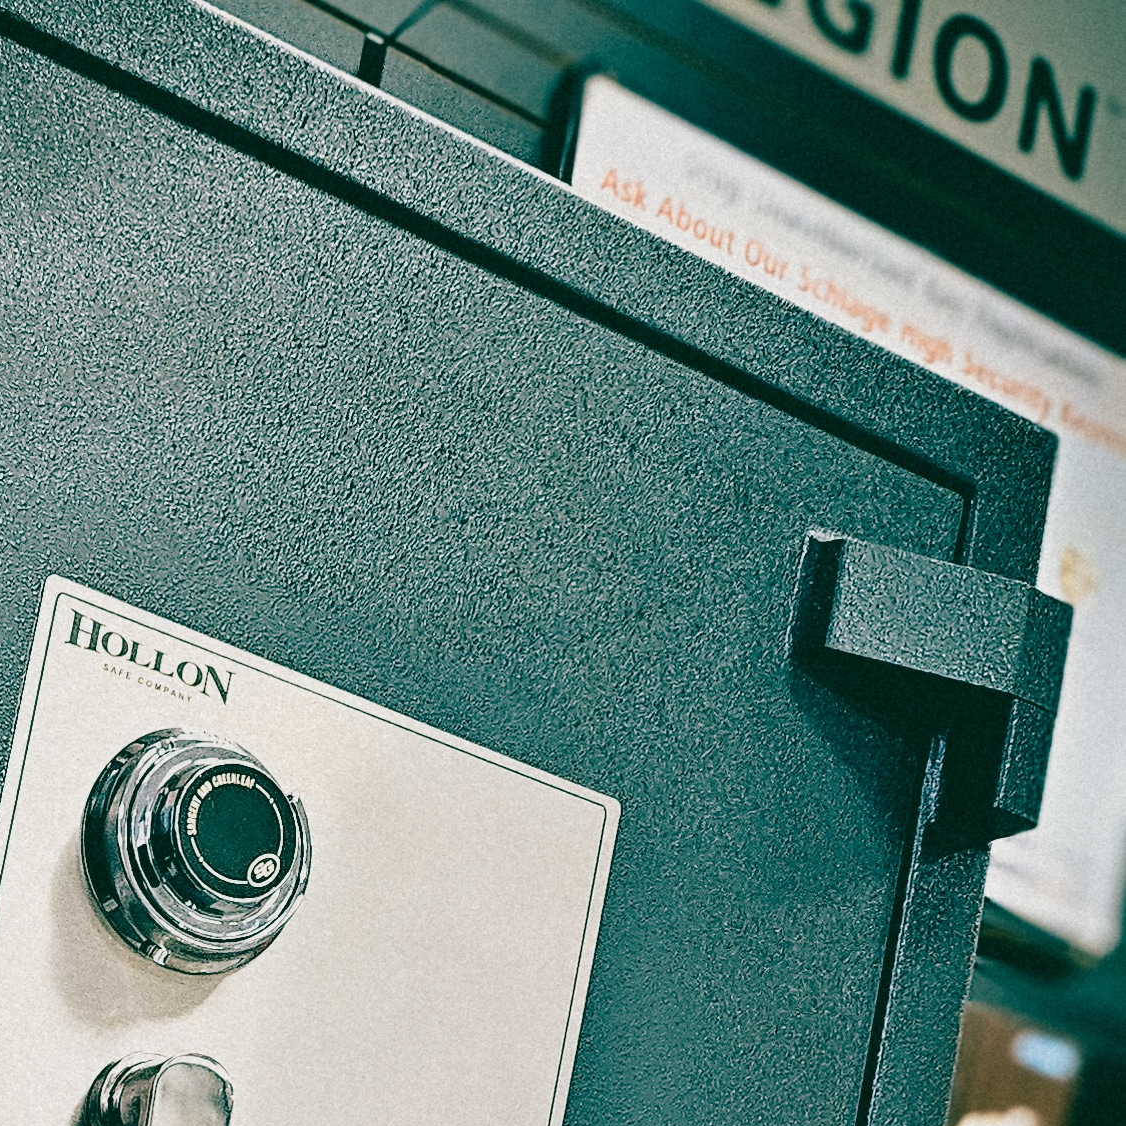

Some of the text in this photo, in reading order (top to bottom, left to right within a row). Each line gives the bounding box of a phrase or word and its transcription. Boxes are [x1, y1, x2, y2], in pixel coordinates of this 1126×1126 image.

[763, 0, 1097, 183] GION
[600, 168, 647, 211] Ask
[657, 196, 735, 255] About
[744, 238, 789, 279] Our
[64, 608, 236, 706] HOLLON
[103, 663, 193, 702] SAFE COMPANY
